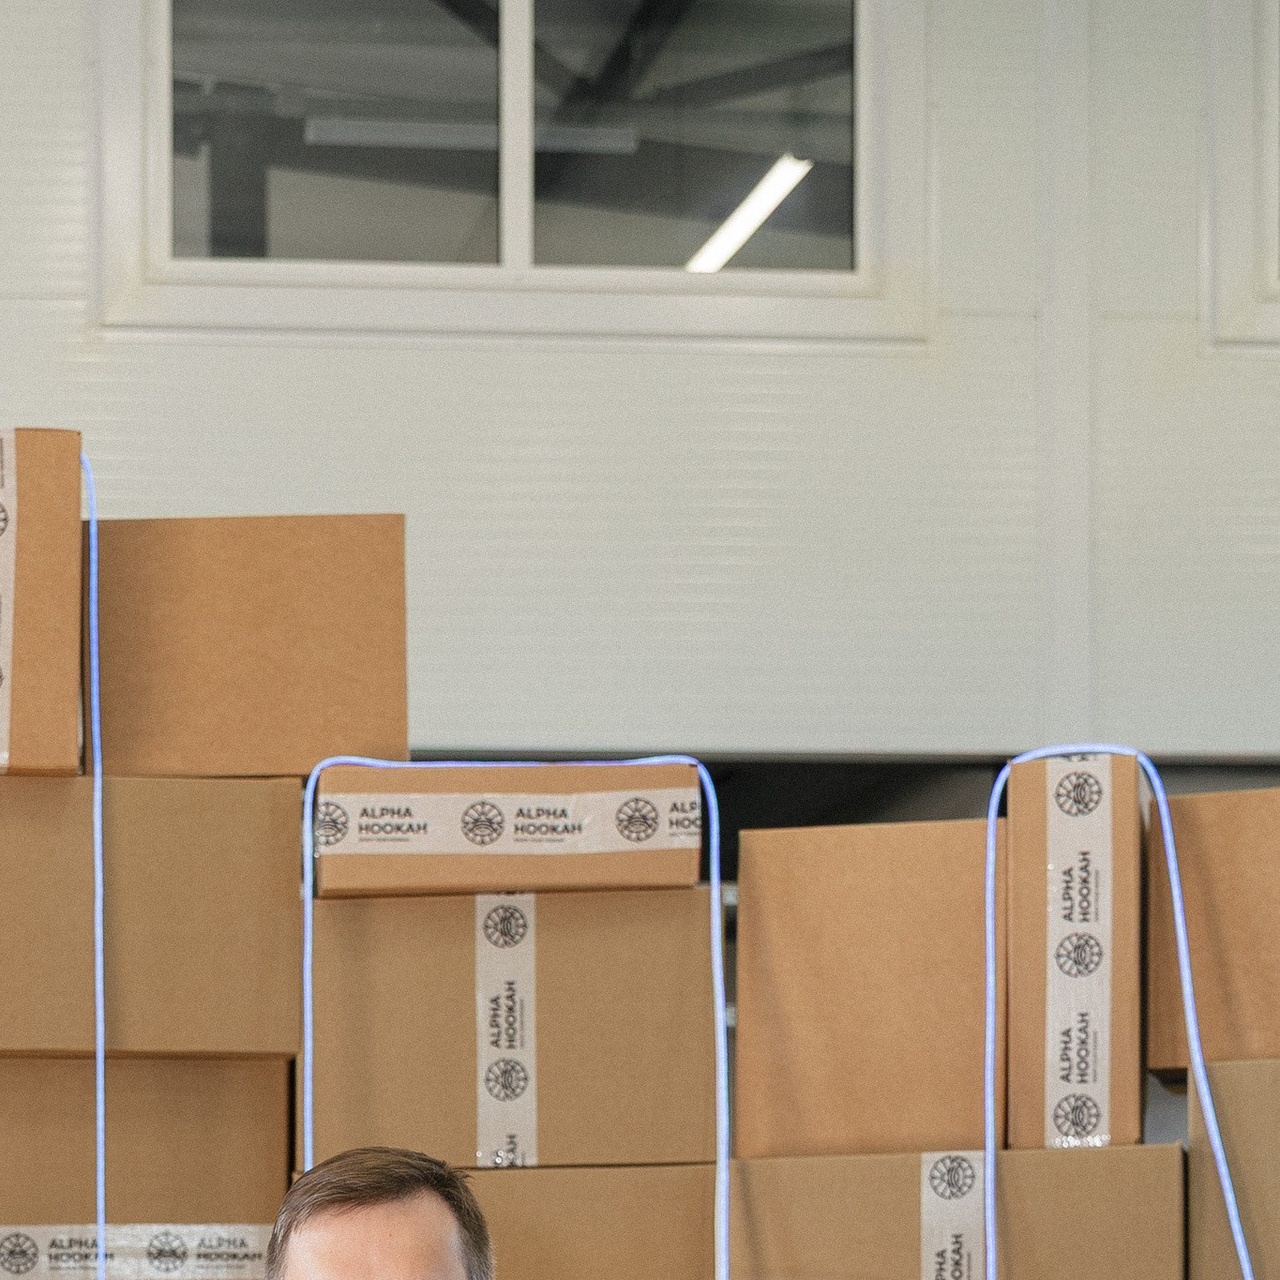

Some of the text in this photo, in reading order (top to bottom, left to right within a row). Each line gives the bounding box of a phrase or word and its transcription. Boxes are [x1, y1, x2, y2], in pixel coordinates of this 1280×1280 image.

[358, 822, 428, 835] HOOKAH
[360, 806, 413, 819] ALPHA
[513, 823, 583, 835] HOOKAH
[516, 807, 568, 819] ALPHA
[1061, 866, 1073, 923] ALPHA
[1078, 850, 1090, 923] HOOKAH
[489, 994, 502, 1049] ALPHA
[504, 979, 517, 1050] HOOKAH
[1059, 1027, 1072, 1084] ALPHA
[1076, 1011, 1089, 1084] HOOKAH
[197, 1237, 248, 1249] ALPHA
